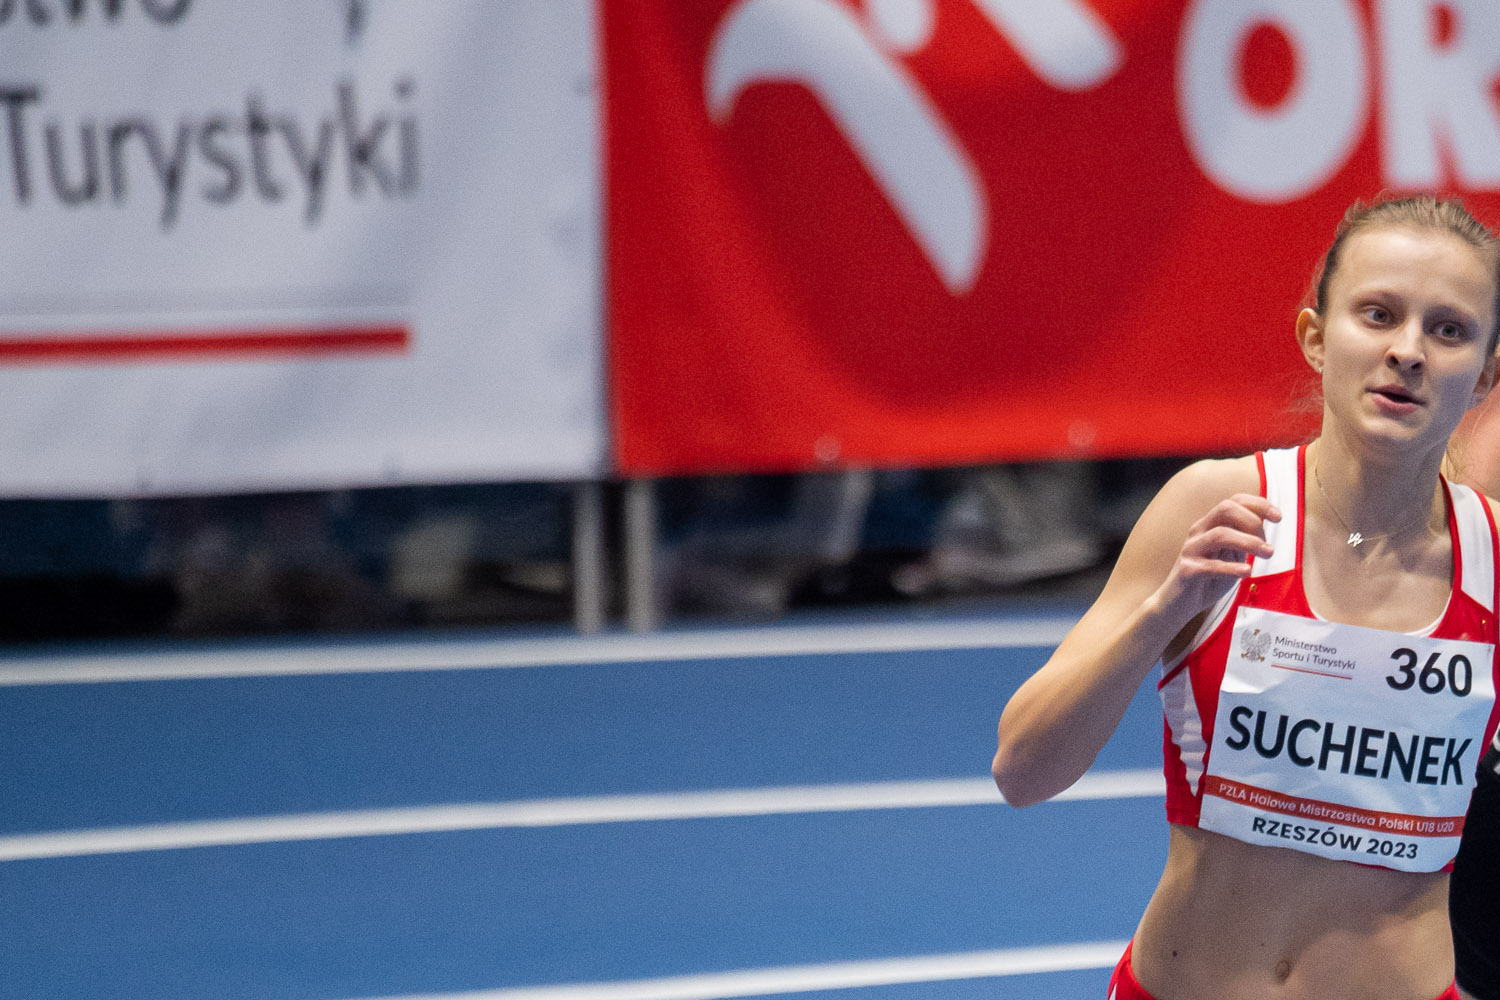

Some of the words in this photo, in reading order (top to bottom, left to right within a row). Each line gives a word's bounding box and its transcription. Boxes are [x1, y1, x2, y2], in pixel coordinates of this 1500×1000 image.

[0, 78, 421, 232] Turystyki
[1272, 647, 1304, 662] Sportu
[1312, 654, 1356, 670] Turystyki
[1274, 635, 1337, 655] Ministerstwo
[1385, 647, 1473, 697] 360
[1225, 705, 1473, 786] SUCHENEK
[1219, 783, 1247, 801] PZLA
[1249, 791, 1297, 812] Halowe
[1299, 802, 1376, 827] Mistrzostwa
[1378, 816, 1414, 831] Polski
[1416, 821, 1435, 833] U18
[1436, 820, 1454, 833] U20
[1252, 816, 1362, 852] RZESZÓW
[1366, 838, 1419, 859] 2023
